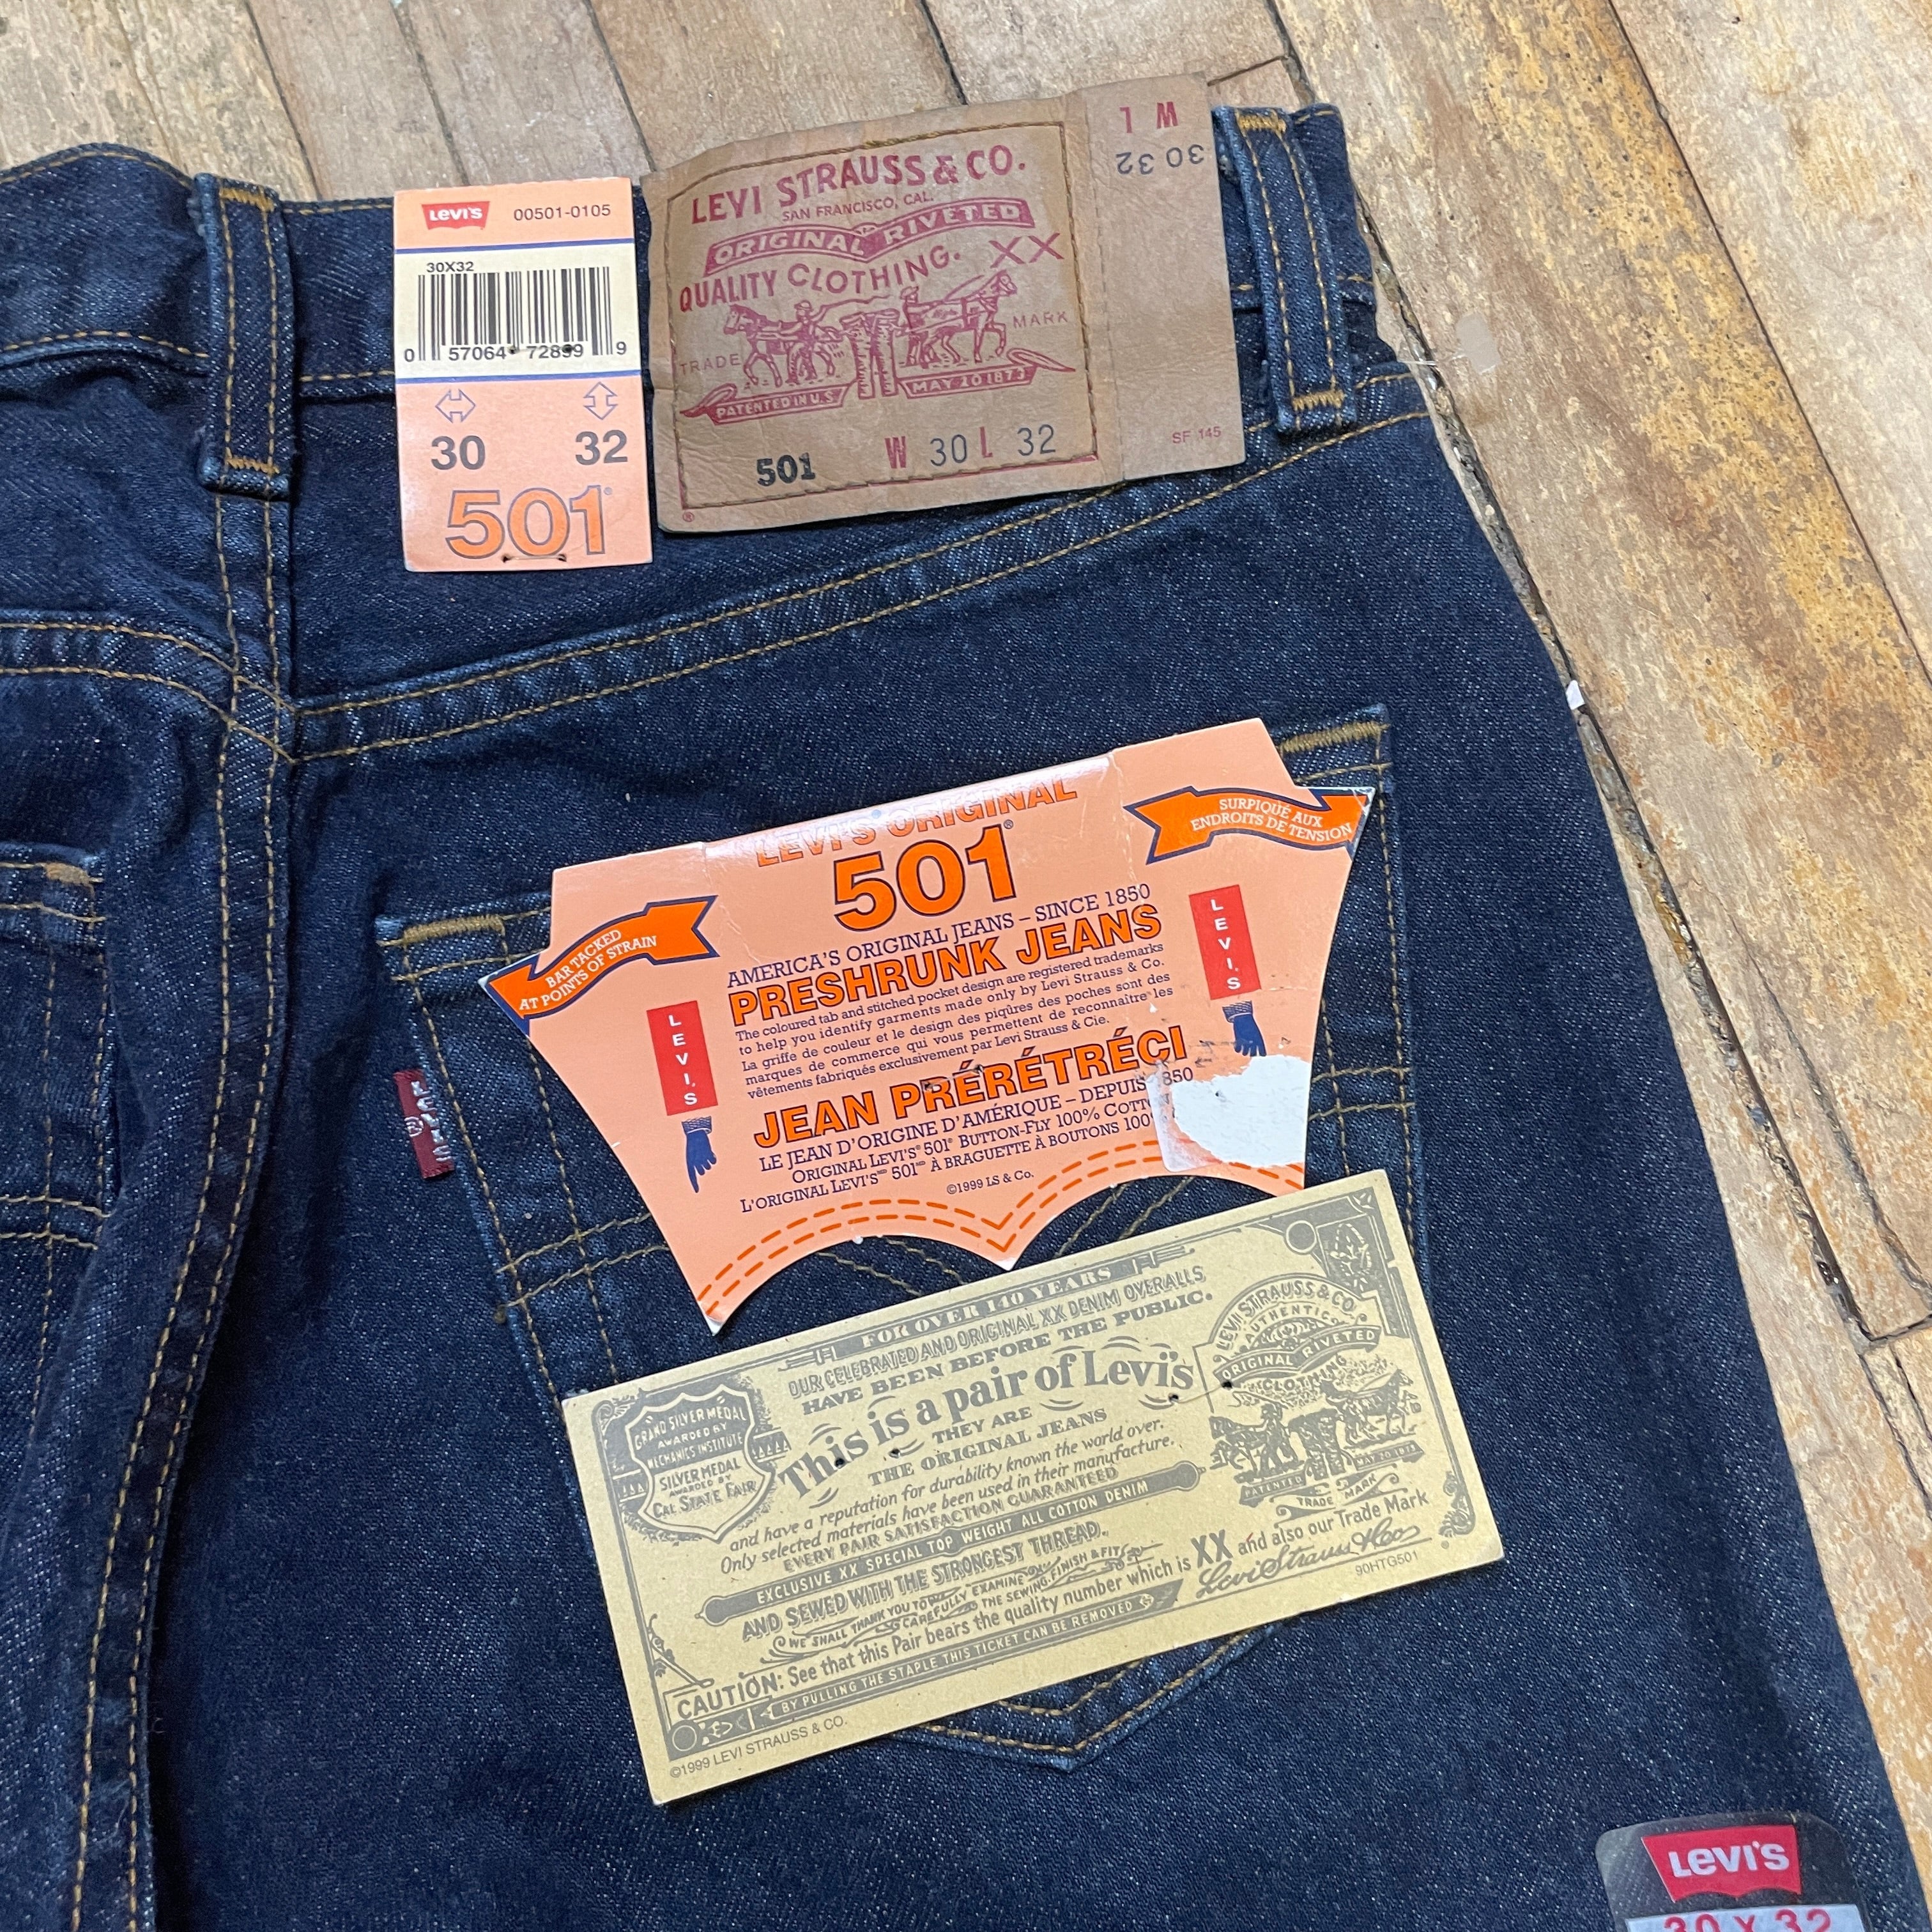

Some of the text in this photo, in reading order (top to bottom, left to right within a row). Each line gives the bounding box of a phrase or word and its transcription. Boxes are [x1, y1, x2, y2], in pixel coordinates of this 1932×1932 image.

[1119, 102, 1178, 133] W L
[692, 144, 1025, 224] LEVI STRAUSS & CO.
[1116, 144, 1204, 175] 30 32
[514, 204, 611, 221] 00501-0105
[712, 204, 1021, 264] ORIGINAL RIVETED
[782, 194, 934, 222] SAN FRANCISCO, CAL.
[426, 262, 474, 273] 30X32
[680, 245, 961, 312] QUALITY CLOTHING.
[990, 233, 1063, 268] XX
[1013, 311, 1069, 328] MARK
[404, 349, 415, 362] 0
[448, 346, 507, 360] 57064
[616, 342, 627, 355] 9
[680, 354, 741, 375] TRADE
[912, 379, 954, 393] MAY
[987, 367, 1025, 383] 1873
[716, 397, 790, 418] PATENTED
[794, 394, 807, 406] IN
[431, 430, 628, 470] 30 32
[756, 424, 1055, 487] 501 W 30 L 32
[1172, 427, 1222, 444] SF 145
[888, 780, 1078, 838] ORIGINAL
[1190, 811, 1352, 842] ENDROITS DE TENSION
[1219, 798, 1323, 828] SURPIQUÉ AUX
[546, 930, 622, 988] BAR TACKED
[727, 950, 841, 988] AMERICA'S
[846, 927, 948, 962] ORIGINAL
[952, 912, 1015, 944] JEANS
[1035, 895, 1100, 922] SINCE
[1107, 884, 1151, 907] 1850
[728, 903, 1162, 1027] PRESHRUNK JEANS
[519, 935, 657, 1011] AT POINTS OF STRAIN
[736, 942, 1163, 1041] The coloured tab and stitched pocket design are registered trademarks
[740, 958, 1165, 1055] to help you identify garments made only by Levi Strauss & Co.
[754, 1091, 879, 1149] JEAN
[889, 1025, 1188, 1120] PRÉRÉTRÉCI
[760, 1154, 783, 1172] LE
[788, 1144, 832, 1170] JEAN
[836, 1121, 938, 1156] D'ORIGINE
[941, 1095, 1061, 1133] D'AMÉRIQUE
[1079, 1078, 1147, 1103] DEPUIS
[947, 1170, 1034, 1194] ©1999 LS & Co.
[788, 1265, 1206, 1399] OUR CELEBRATED AND ORIGINAL XX DENIM OVERALLS
[862, 1266, 1112, 1348] FOR OVER 140 YEARS
[1216, 1315, 1242, 1351] LEVI
[1238, 1280, 1314, 1317] STRAUSS
[1317, 1284, 1330, 1299] &
[1245, 1301, 1333, 1342] AUTHENTIC
[801, 1291, 1213, 1415] HAVE BEEN BEFORE THE PUBLIC.
[1222, 1331, 1376, 1380] ORIGINAL RIVETED
[778, 1350, 1194, 1498] This is a pair of Levi's
[868, 1407, 1108, 1487] THE ORIGINAL JEANS
[932, 1407, 1033, 1445] THEY ARE
[741, 1520, 1109, 1642] AND SEWED WITH THE STRONGEST THREAD.
[1354, 1551, 1420, 1576] 90HTG501
[670, 1715, 848, 1778] ©1999 LEVI STRAUSS & CO.
